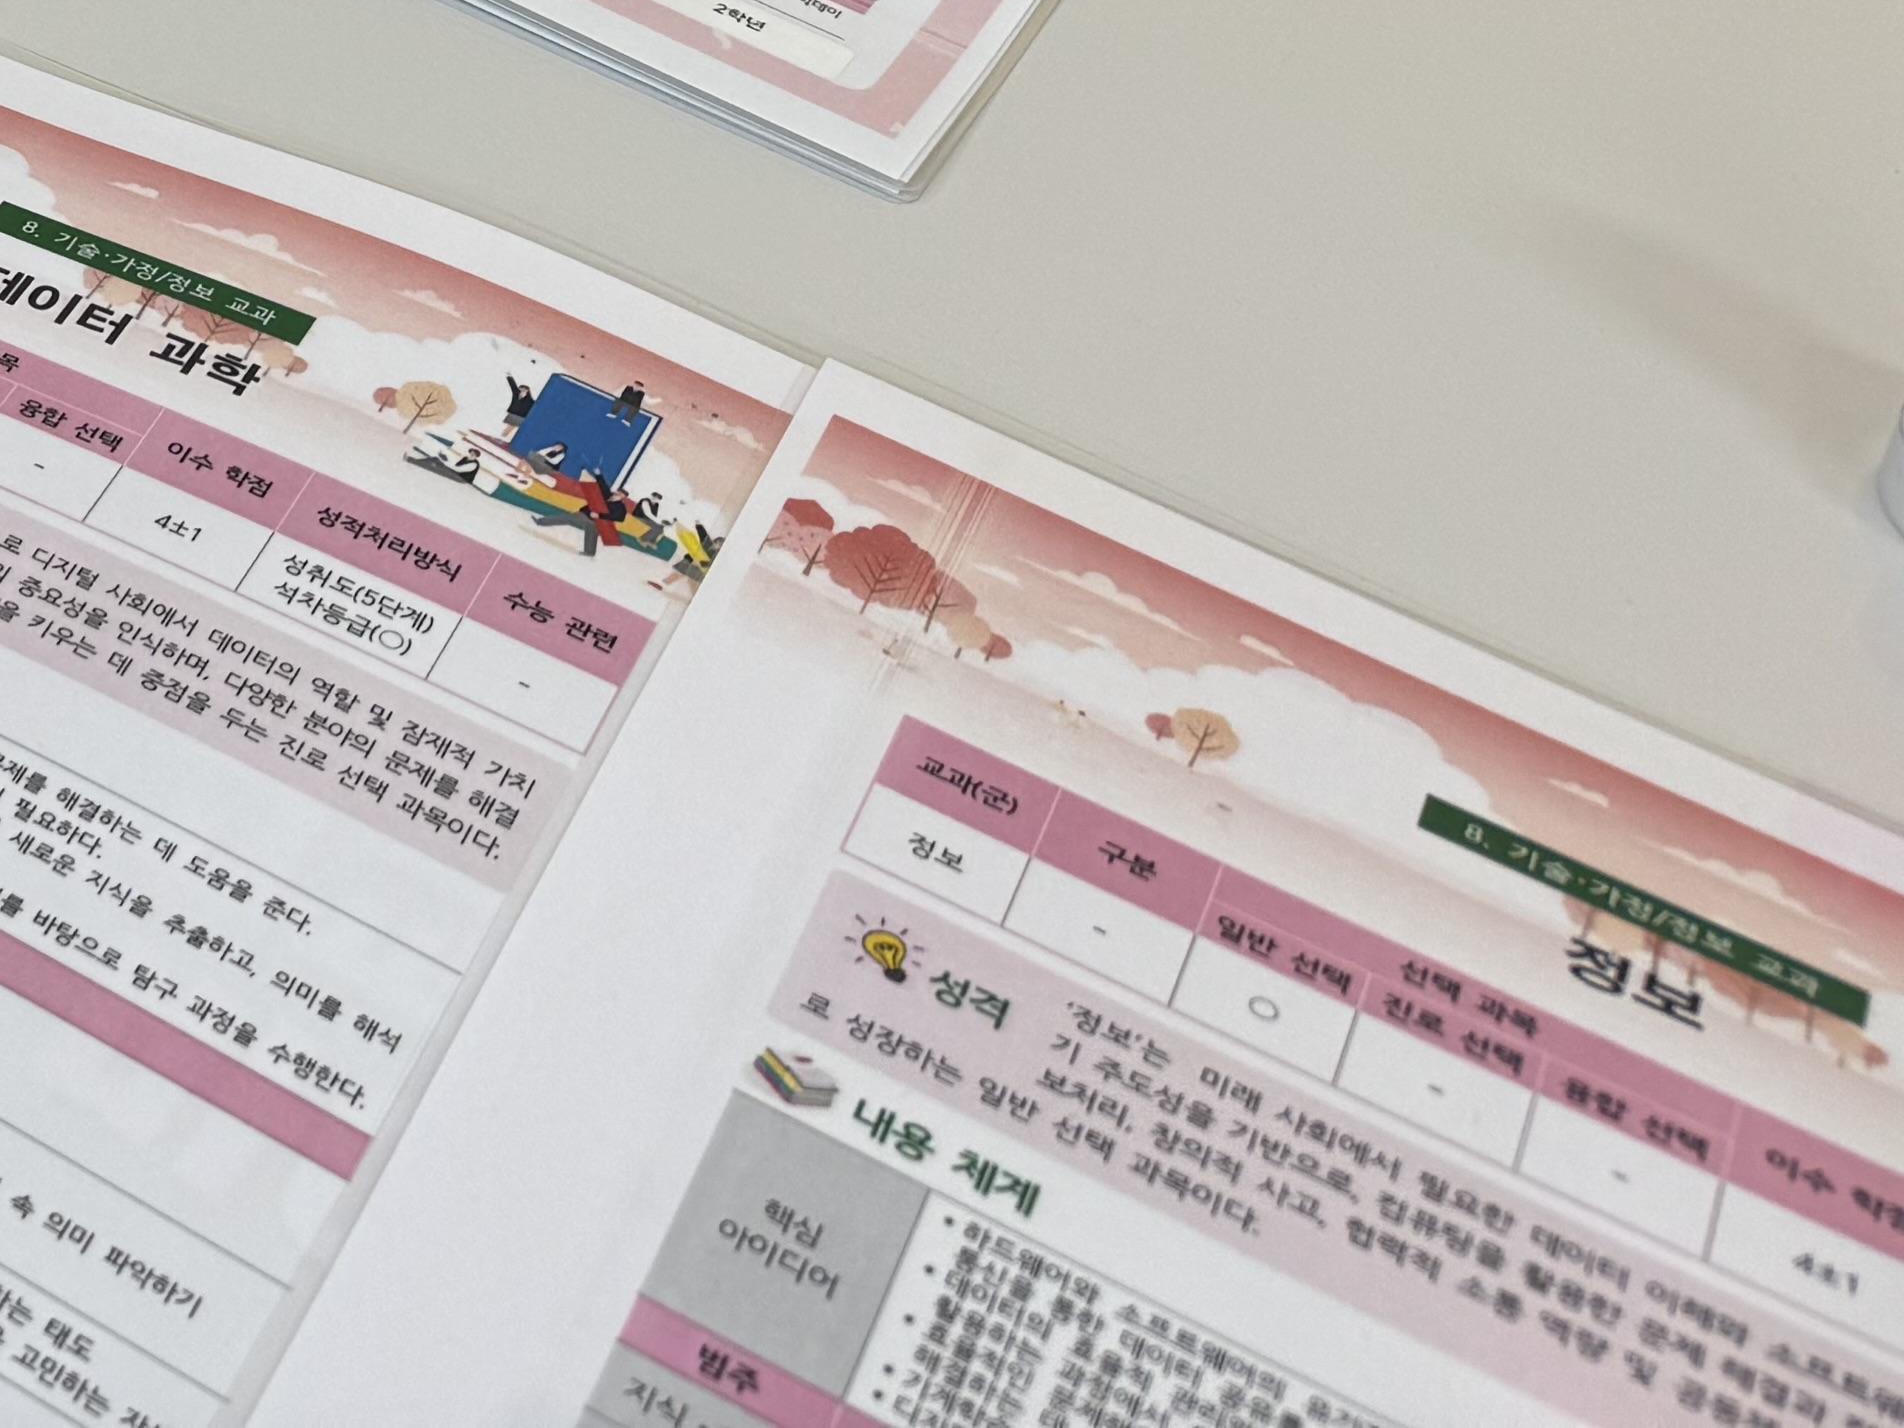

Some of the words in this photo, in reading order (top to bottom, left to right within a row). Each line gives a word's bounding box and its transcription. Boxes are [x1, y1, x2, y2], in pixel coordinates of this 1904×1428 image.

[711, 2, 767, 33] 2학년
[21, 219, 40, 238] 8.
[224, 296, 277, 326] 교과
[148, 331, 268, 397] 과학
[18, 398, 69, 429] 융합
[73, 421, 124, 454] 선택
[167, 441, 214, 472] 이수
[225, 464, 274, 499] 학점
[153, 514, 202, 543] 4±1
[316, 506, 463, 583] 성적처리방식
[282, 553, 435, 635] 성취도(5단계)
[502, 591, 555, 624] 수능
[564, 615, 619, 655] 관련
[915, 755, 1019, 816] 교과(군)
[907, 831, 964, 874] 정보
[1097, 840, 1157, 882] 구분
[1217, 914, 1279, 959] 일반
[1290, 951, 1353, 997] 선택
[1564, 935, 1704, 1031] 정보
[928, 969, 1011, 1031] 성격
[1399, 959, 1463, 1005] 선택
[1474, 994, 1539, 1040] 과목
[1381, 992, 1445, 1038] 진로
[1459, 1029, 1525, 1077] 선택
[799, 991, 831, 1021] 로
[845, 1012, 963, 1088] 성장하는
[978, 1076, 1041, 1125] 일반
[1051, 1115, 1117, 1165] 선택
[1127, 1151, 1259, 1235] 과목이다.
[851, 1097, 936, 1163] 내용
[950, 1148, 1041, 1219] 체계
[763, 1197, 824, 1250] 핵심
[717, 1217, 841, 1301] 아이디어
[697, 1342, 760, 1395] 범주
